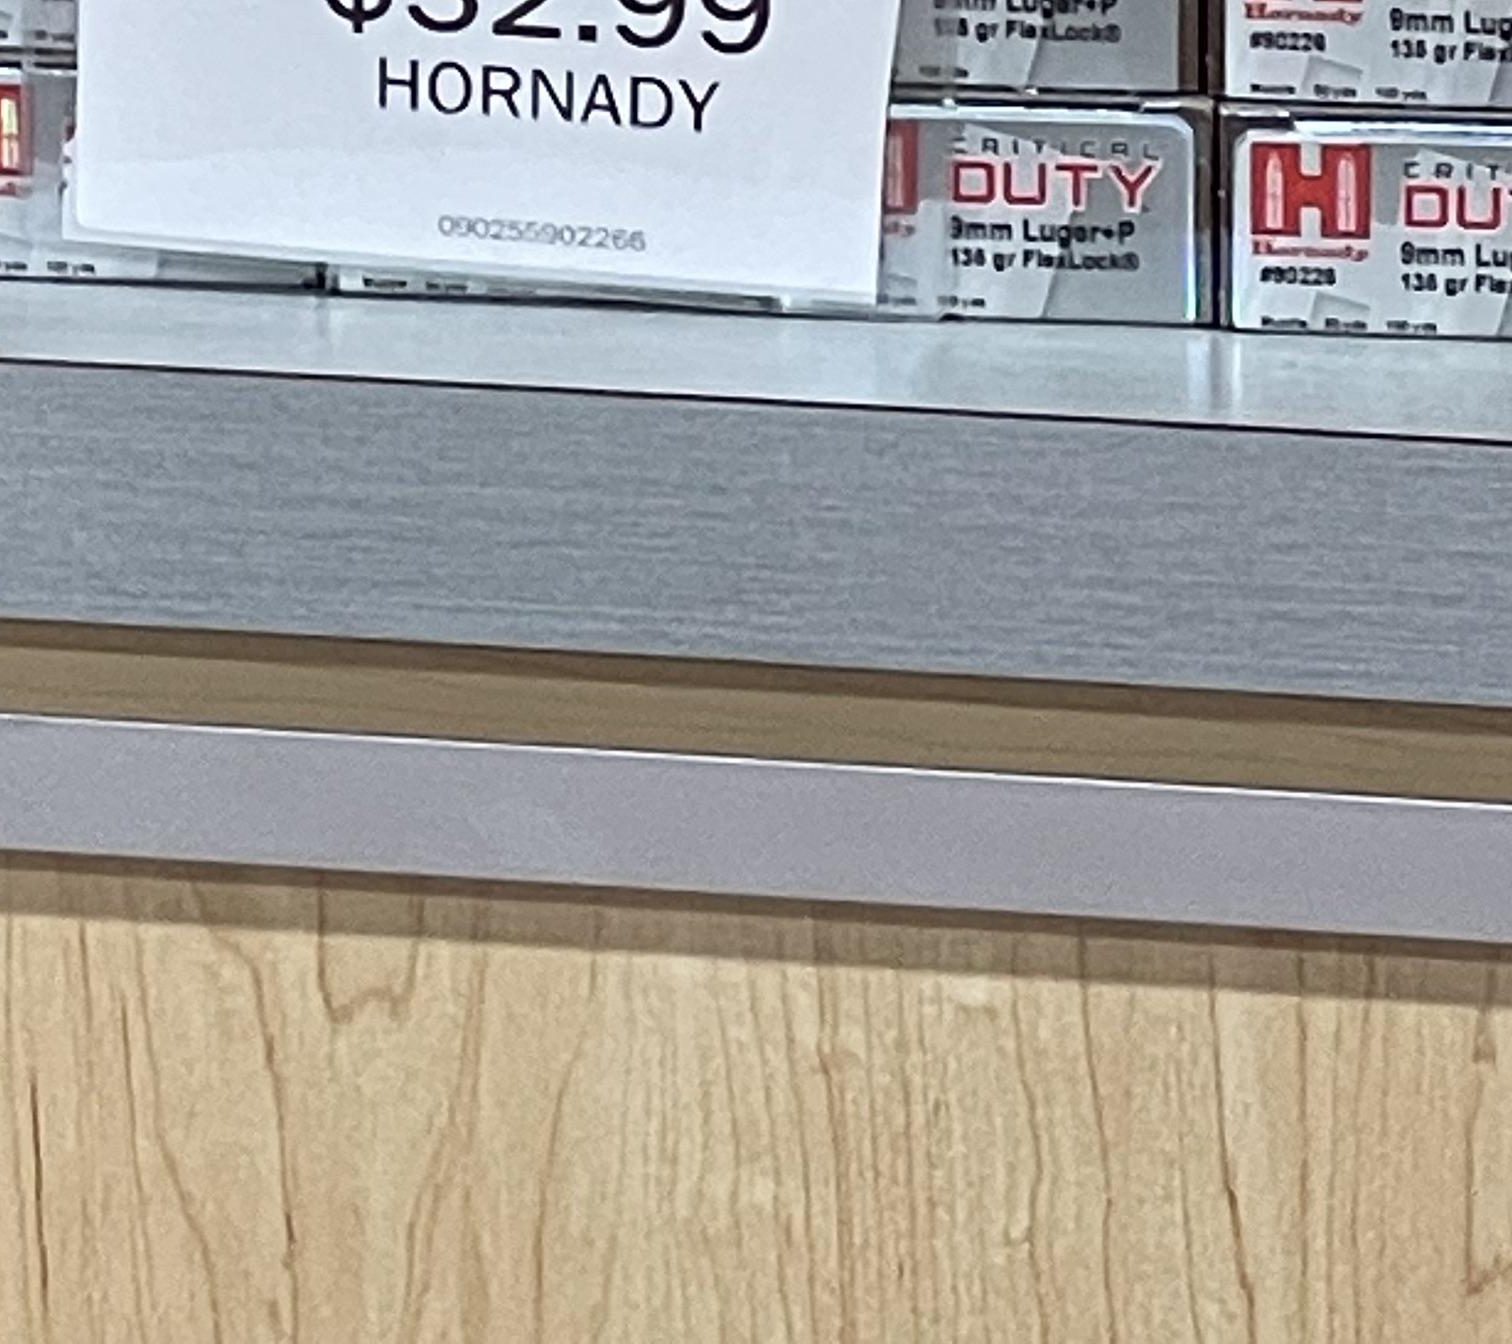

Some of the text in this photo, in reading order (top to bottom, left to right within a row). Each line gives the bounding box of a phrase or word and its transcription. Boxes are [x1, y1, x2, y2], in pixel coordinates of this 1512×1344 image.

[1389, 8, 1455, 34] 9mm
[377, 57, 722, 134] HORNADY
[952, 161, 1154, 209] DUTY
[1403, 183, 1512, 231] DU
[949, 214, 1013, 241] 9mm
[1022, 218, 1136, 249] Luger+P
[1400, 241, 1465, 266] 9mm
